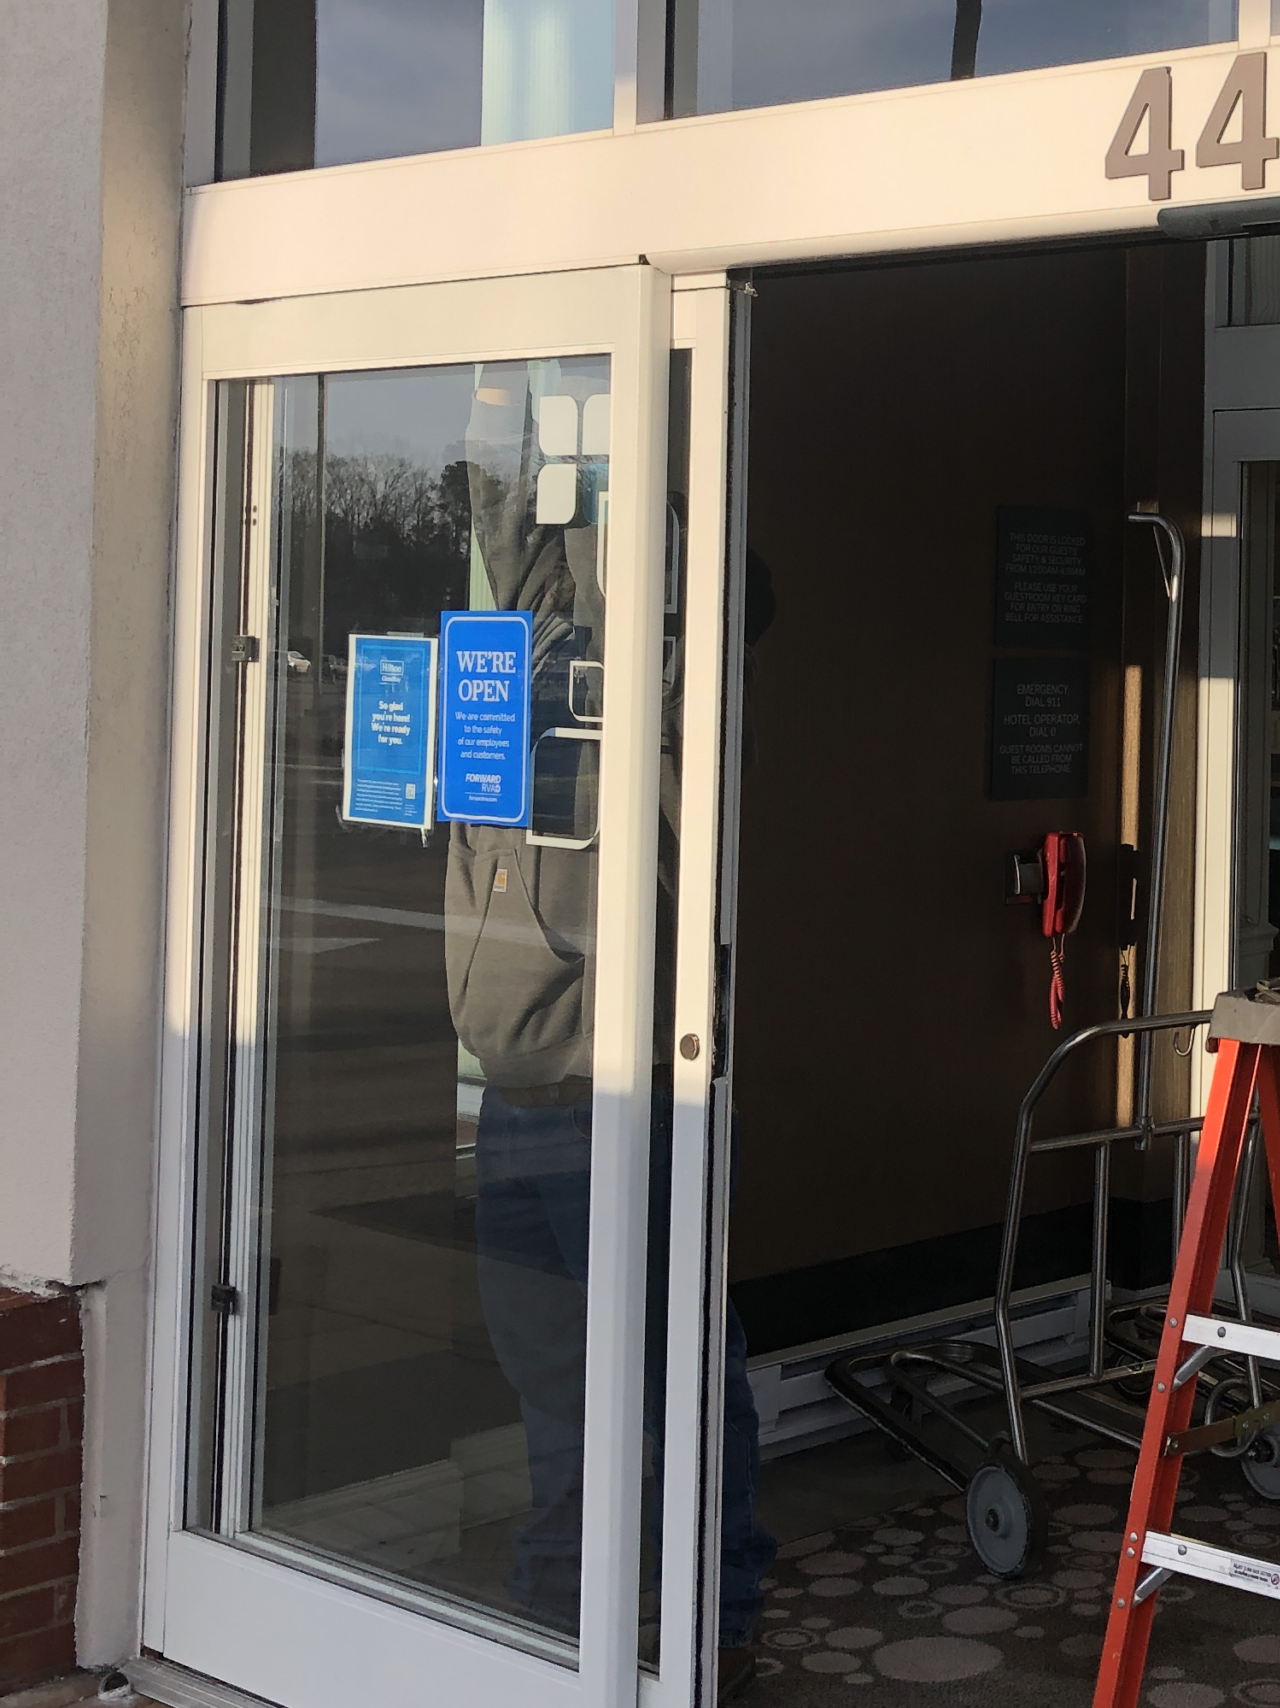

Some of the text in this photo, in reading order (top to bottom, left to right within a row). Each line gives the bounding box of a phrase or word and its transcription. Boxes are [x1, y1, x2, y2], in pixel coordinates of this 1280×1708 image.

[1009, 533, 1026, 542] THIS
[1027, 534, 1048, 544] DOOR
[1016, 544, 1048, 554] FOR OUR
[1012, 553, 1040, 564] SAFETY
[1048, 556, 1082, 566] SECURITY
[1005, 564, 1027, 572] FROM
[1014, 582, 1078, 593] PLEASE USE YOUR
[1052, 594, 1066, 603] KEY
[1067, 594, 1087, 604] CARD
[1010, 602, 1026, 611] FOR
[1026, 603, 1050, 612] ENTRY
[1051, 604, 1062, 612] OR
[1005, 612, 1023, 622] BELL
[1024, 612, 1039, 622] FOR
[382, 662, 402, 672] Hilton
[456, 651, 516, 674] WE'RE
[458, 679, 510, 702] OPEN
[378, 701, 403, 712] So glad
[1025, 696, 1061, 707] DIAL 911
[372, 711, 410, 722] you're here!
[455, 712, 466, 720] We
[480, 713, 515, 722] committed
[1004, 714, 1032, 725] HOTEL
[371, 722, 410, 736] We're ready
[464, 725, 502, 735] to the safety
[1030, 726, 1048, 737] DIAL
[378, 734, 403, 746] for you.
[458, 737, 464, 745] of
[476, 739, 510, 749] employees
[1000, 743, 1083, 754] GUEST ROOMS CANNOT
[460, 750, 506, 760] and customers.
[1012, 754, 1072, 764] BE CALLED FROM
[1011, 766, 1027, 775] THIS
[465, 773, 501, 783] FORWARD
